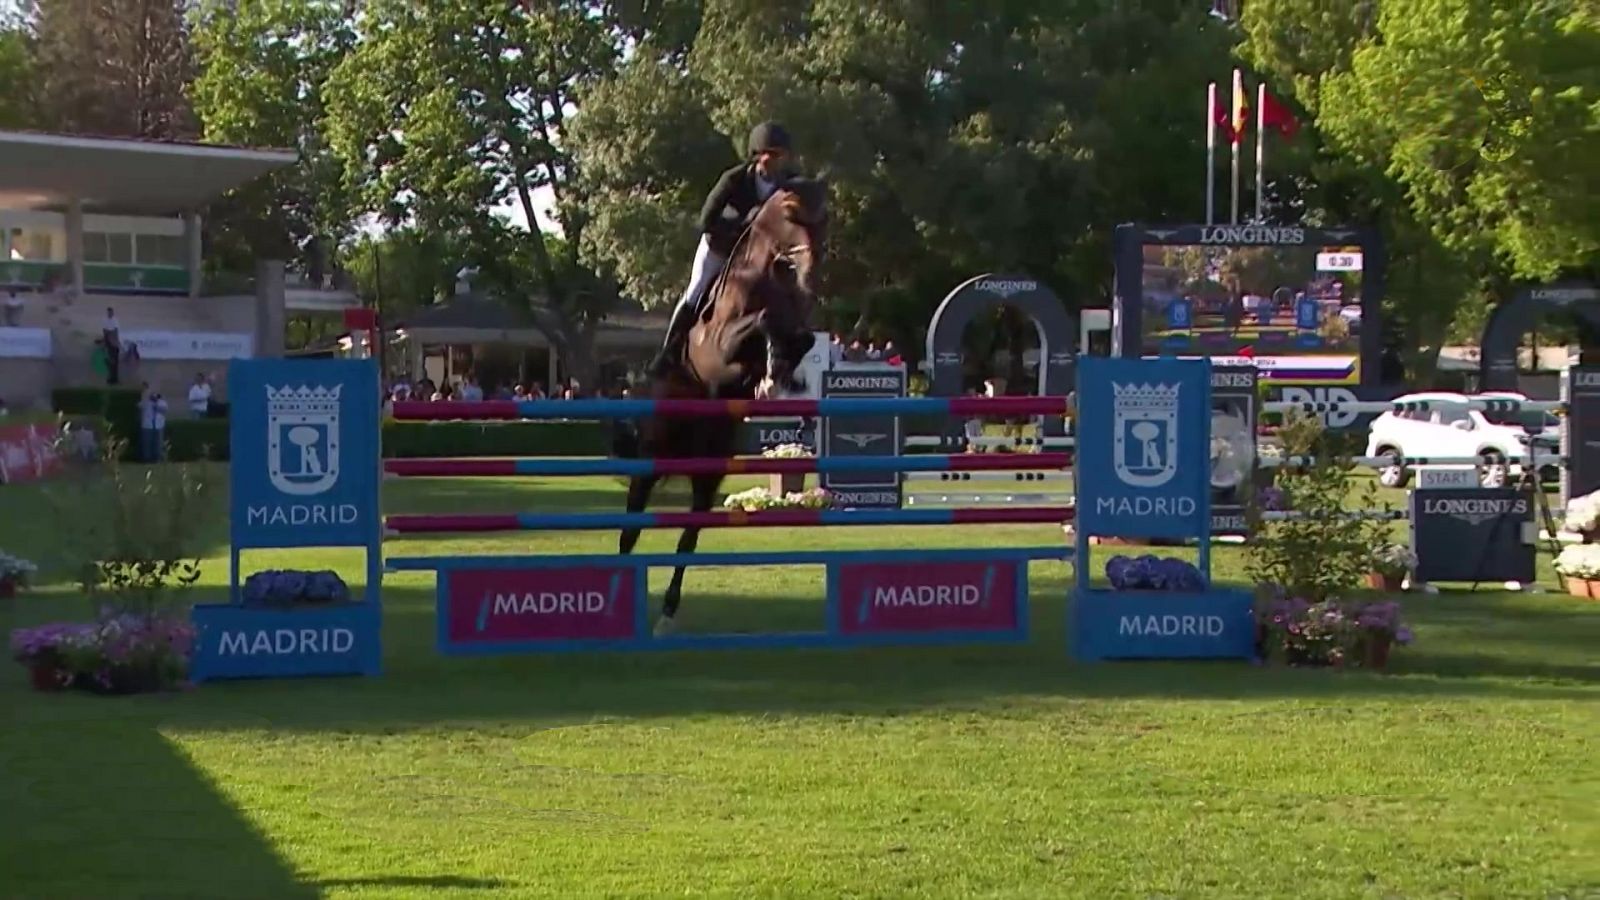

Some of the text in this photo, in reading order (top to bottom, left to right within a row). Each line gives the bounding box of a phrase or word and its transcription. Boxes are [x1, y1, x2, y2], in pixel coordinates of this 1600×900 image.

[1200, 227, 1304, 243] LONGINES
[974, 280, 1037, 290] LONGINES
[827, 376, 899, 389] LONGINES
[1427, 473, 1467, 484] START
[834, 492, 898, 503] ONGINES
[247, 504, 358, 525] MADRID
[1096, 497, 1196, 516] MADRID
[1424, 500, 1527, 513] LONGINES
[493, 592, 605, 615] MADRID
[874, 585, 980, 607] MADRID
[1119, 615, 1224, 637] MADRID
[218, 628, 354, 656] MADRID
